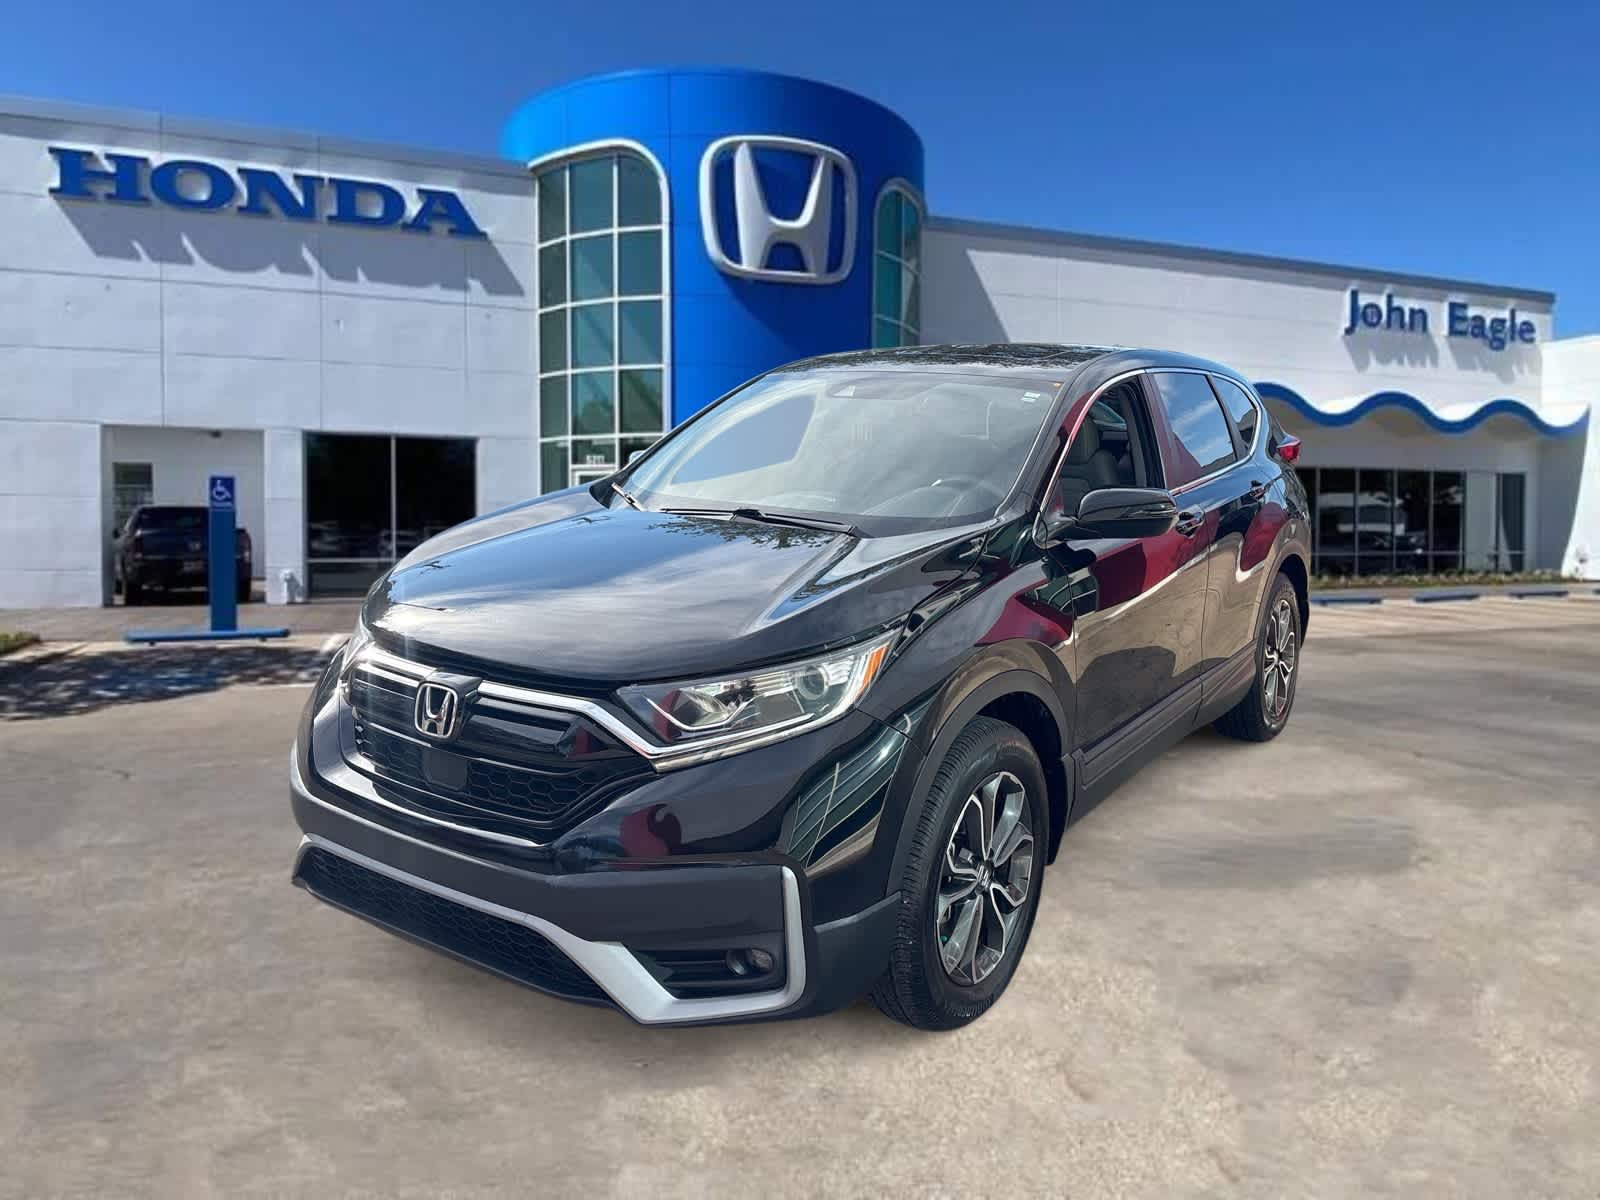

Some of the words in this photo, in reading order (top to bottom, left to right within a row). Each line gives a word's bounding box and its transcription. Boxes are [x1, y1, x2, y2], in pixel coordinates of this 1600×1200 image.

[48, 146, 488, 239] HONDA
[1344, 289, 1429, 336] John
[1448, 301, 1536, 352] Eagle
